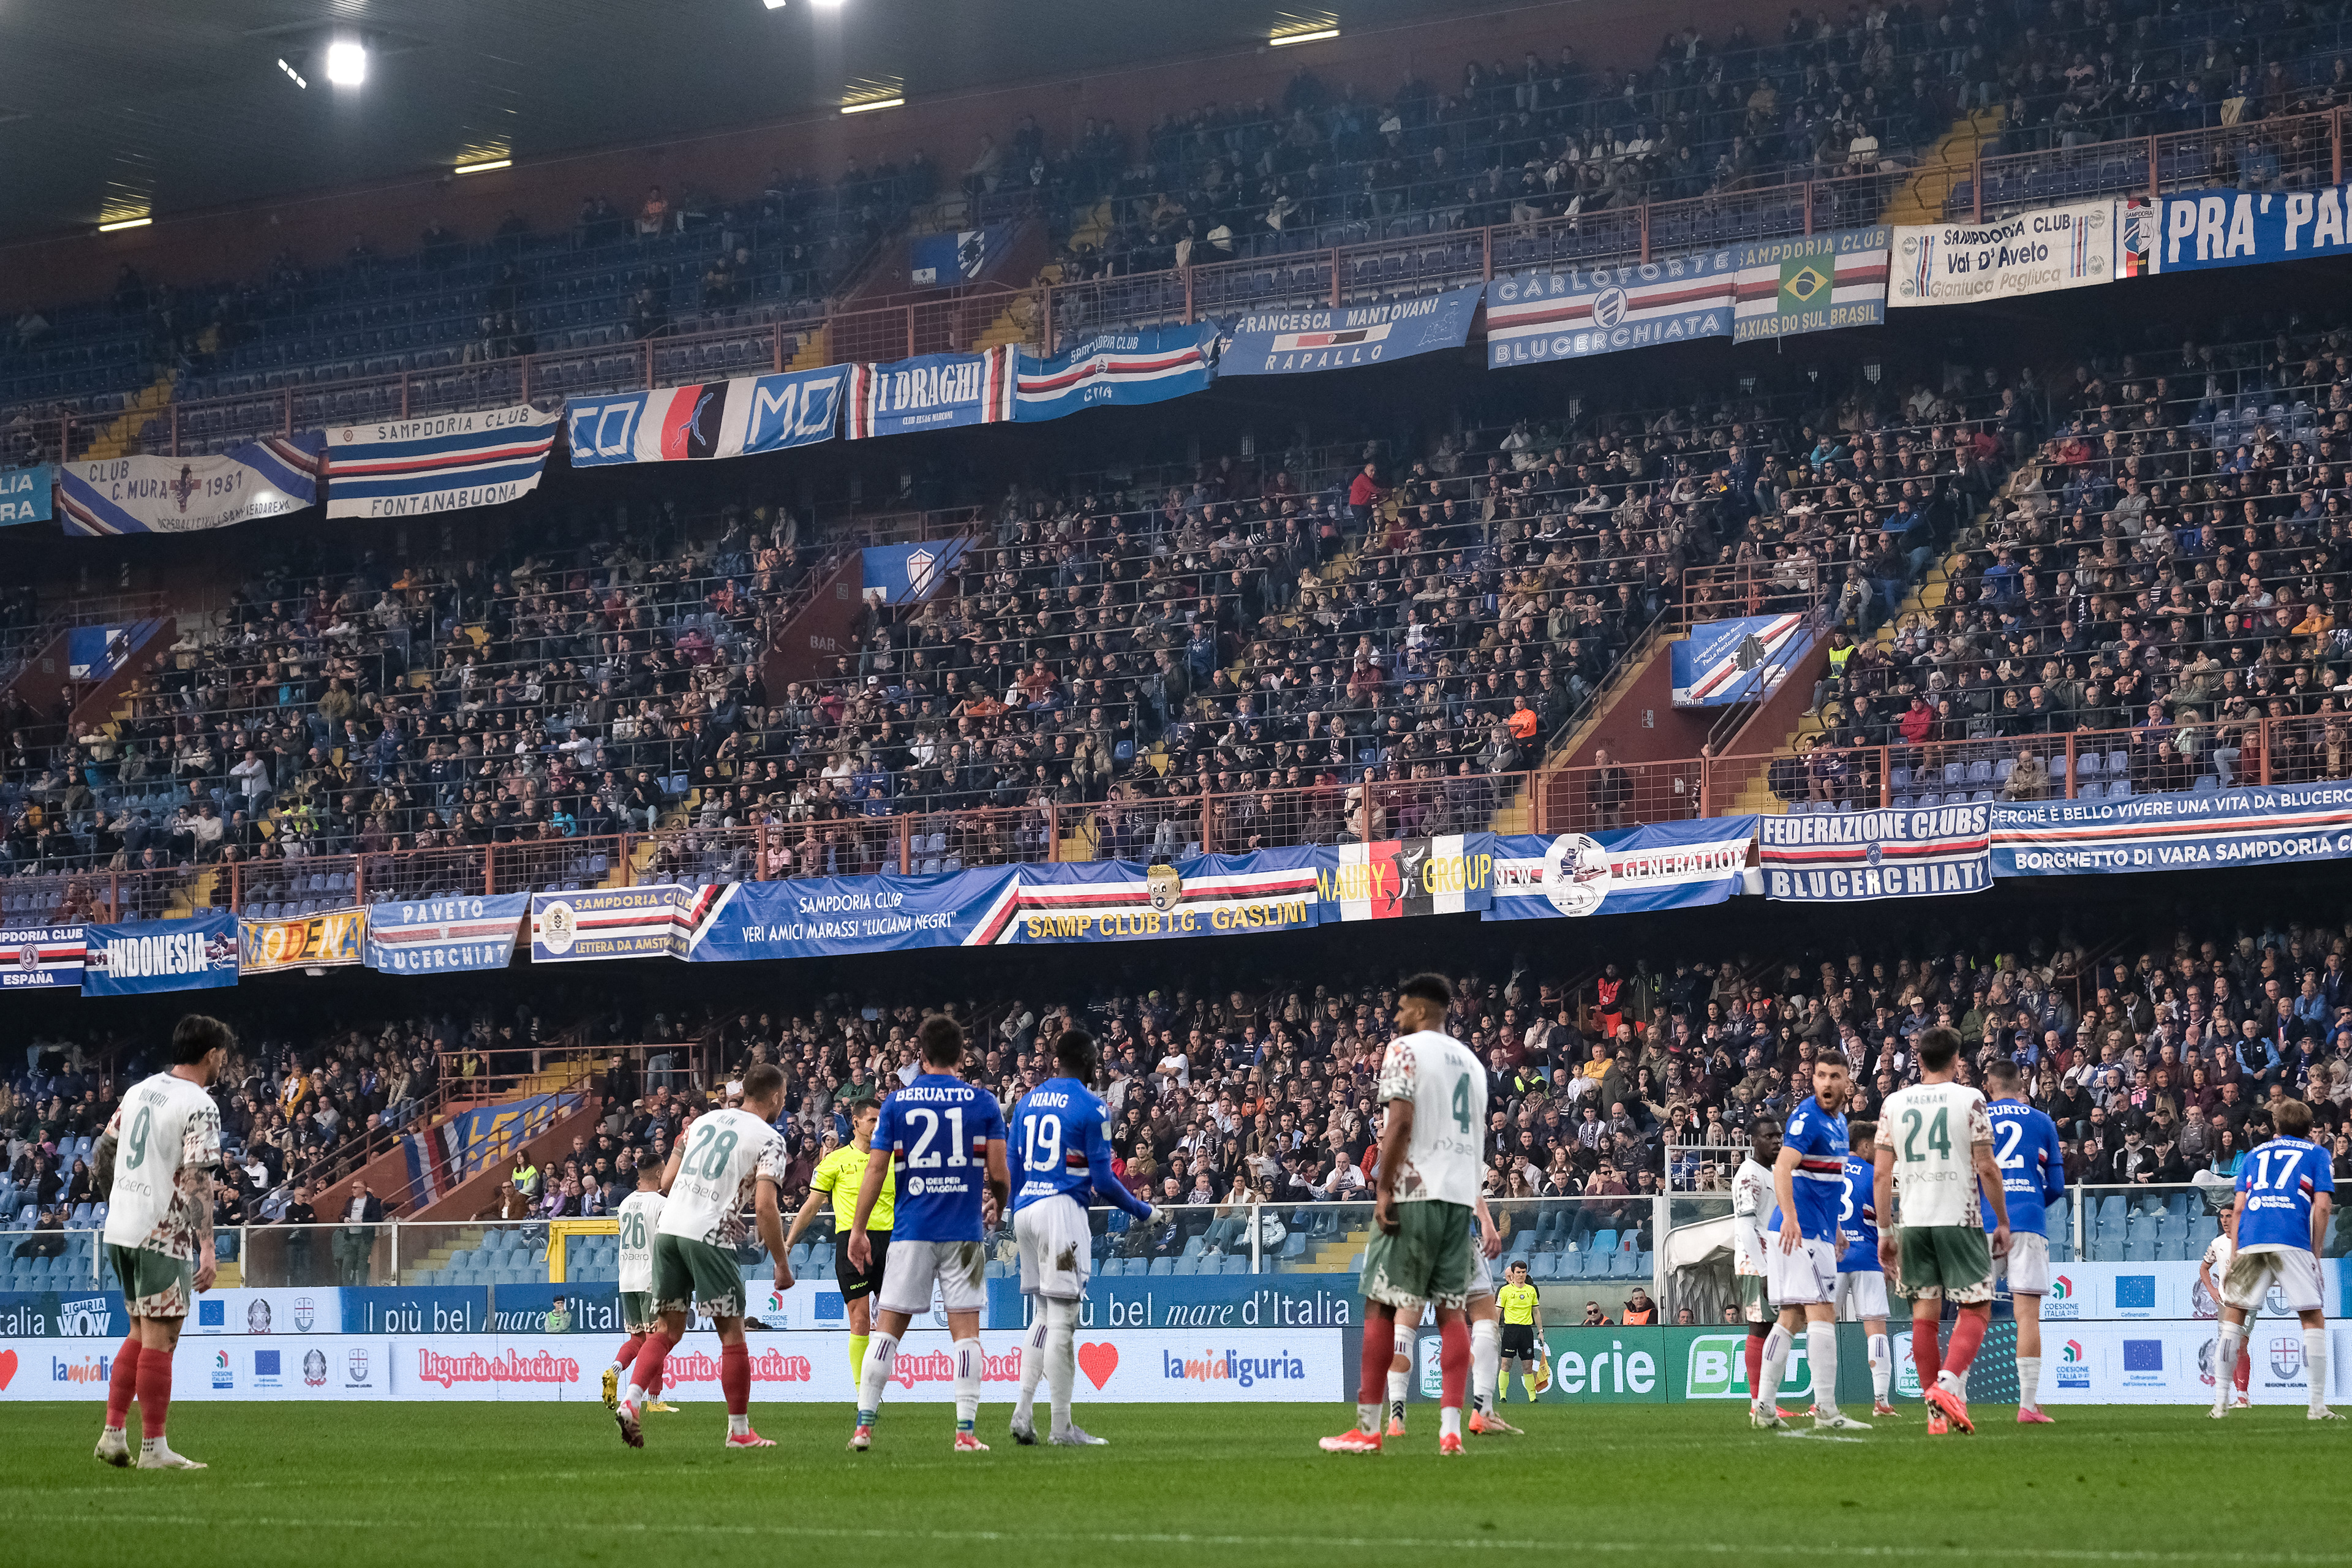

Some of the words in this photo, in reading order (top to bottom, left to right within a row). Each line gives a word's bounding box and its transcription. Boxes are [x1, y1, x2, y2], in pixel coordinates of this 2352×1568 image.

[1841, 230, 1885, 251] CLUB
[1943, 217, 2025, 246] SAMPDORIA
[2033, 214, 2070, 233] CLUB
[2168, 194, 2272, 263] PRA'
[1499, 251, 1730, 301] CARLOFORTE
[1947, 252, 1970, 274] Val
[1931, 277, 1994, 298] Gianluca
[2000, 268, 2061, 292] Pagliuca
[1235, 312, 1332, 334] FRANCESCA
[1346, 297, 1439, 328] MANTOVANI
[1734, 317, 1779, 340] CAXIAS
[1782, 314, 1798, 333] DO
[1802, 311, 1826, 329] SUL
[1830, 304, 1879, 326] BRASIL
[1117, 336, 1139, 350] CLUB
[1494, 313, 1720, 363] BLUCERCHIATA
[1265, 345, 1383, 370] RAPALLO
[878, 374, 889, 411] I
[894, 361, 981, 410] DRAGHI
[379, 415, 472, 440] SAMPDORIA
[486, 407, 529, 428] CLUB
[903, 415, 915, 425] CLUB
[89, 461, 129, 482] CLUB
[371, 483, 517, 516] FONTANABUONA
[810, 635, 835, 652] BAR
[1693, 641, 1718, 664] Sampdoria
[1730, 621, 1745, 634] Roma
[1716, 631, 1741, 655] Mantovani
[1991, 805, 2046, 823] PERCHÉ
[2050, 805, 2060, 821] È
[2064, 805, 2113, 821] BELLO
[2117, 801, 2173, 818] VIVERE
[2177, 798, 2210, 814] UNA
[2214, 796, 2250, 811] VITA
[2254, 794, 2276, 809] DA
[2280, 788, 2352, 807] BLUCERC
[1763, 812, 1906, 845] FEDERAZIONE
[1912, 805, 1987, 839] CLUBS
[1493, 865, 1532, 889] NEW
[1622, 846, 1747, 881] GENERATION
[2015, 849, 2128, 870] BORGHETTO
[2134, 848, 2152, 865] DI
[2157, 843, 2209, 864] VARA
[2215, 837, 2333, 861] SAMPDORIA
[2337, 835, 2352, 851] C
[1316, 862, 1387, 902] MAURY
[1422, 853, 1492, 894] GROUP
[1771, 860, 1984, 897] BLUCERCHIATI
[402, 899, 484, 924] PAVETO
[575, 894, 656, 911] SAMPDORIA
[799, 894, 872, 914] SAMPDORIA
[875, 892, 903, 909] CLUB
[1027, 915, 1092, 938] SAMP
[1098, 912, 1161, 937] CLUB
[1167, 909, 1202, 933] I.G.
[1212, 900, 1307, 929] GASLINI
[52, 927, 83, 940] CLUB
[241, 916, 362, 966] MODENA
[575, 938, 615, 954] LETTERA
[617, 937, 632, 951] DA
[742, 924, 765, 943] VERI
[769, 922, 803, 941] AMICI
[806, 920, 859, 940] MARASSI
[106, 932, 208, 979] INDONESIA
[3, 970, 54, 986] ESPAÑA
[895, 1087, 975, 1102] BERUATTO
[1028, 1092, 1069, 1108] NIANG
[1452, 1072, 1471, 1134] 4
[1986, 1105, 2030, 1116] CURTO
[716, 1114, 737, 1127] BLIN
[1902, 1107, 1951, 1163] 24
[126, 1106, 150, 1170] 9
[680, 1125, 739, 1181] 28
[905, 1107, 968, 1169] 21
[1023, 1114, 1061, 1172] 19
[1994, 1120, 2024, 1169] 2
[2253, 1149, 2304, 1191] 17
[925, 1184, 968, 1193] VIAGGIARE
[628, 1202, 643, 1210] VERRE
[621, 1212, 646, 1250] 26
[56, 1309, 111, 1336] WOW
[62, 1299, 105, 1315] LIGURIA
[385, 1301, 422, 1333] più
[434, 1300, 471, 1332] bel
[481, 1311, 546, 1332] mare
[1109, 1292, 1153, 1327] bel
[1164, 1301, 1234, 1327] mare
[419, 1348, 491, 1389] Liguria
[490, 1356, 507, 1378] da
[507, 1348, 579, 1383] baciare
[1163, 1348, 1305, 1388] lamialiguria
